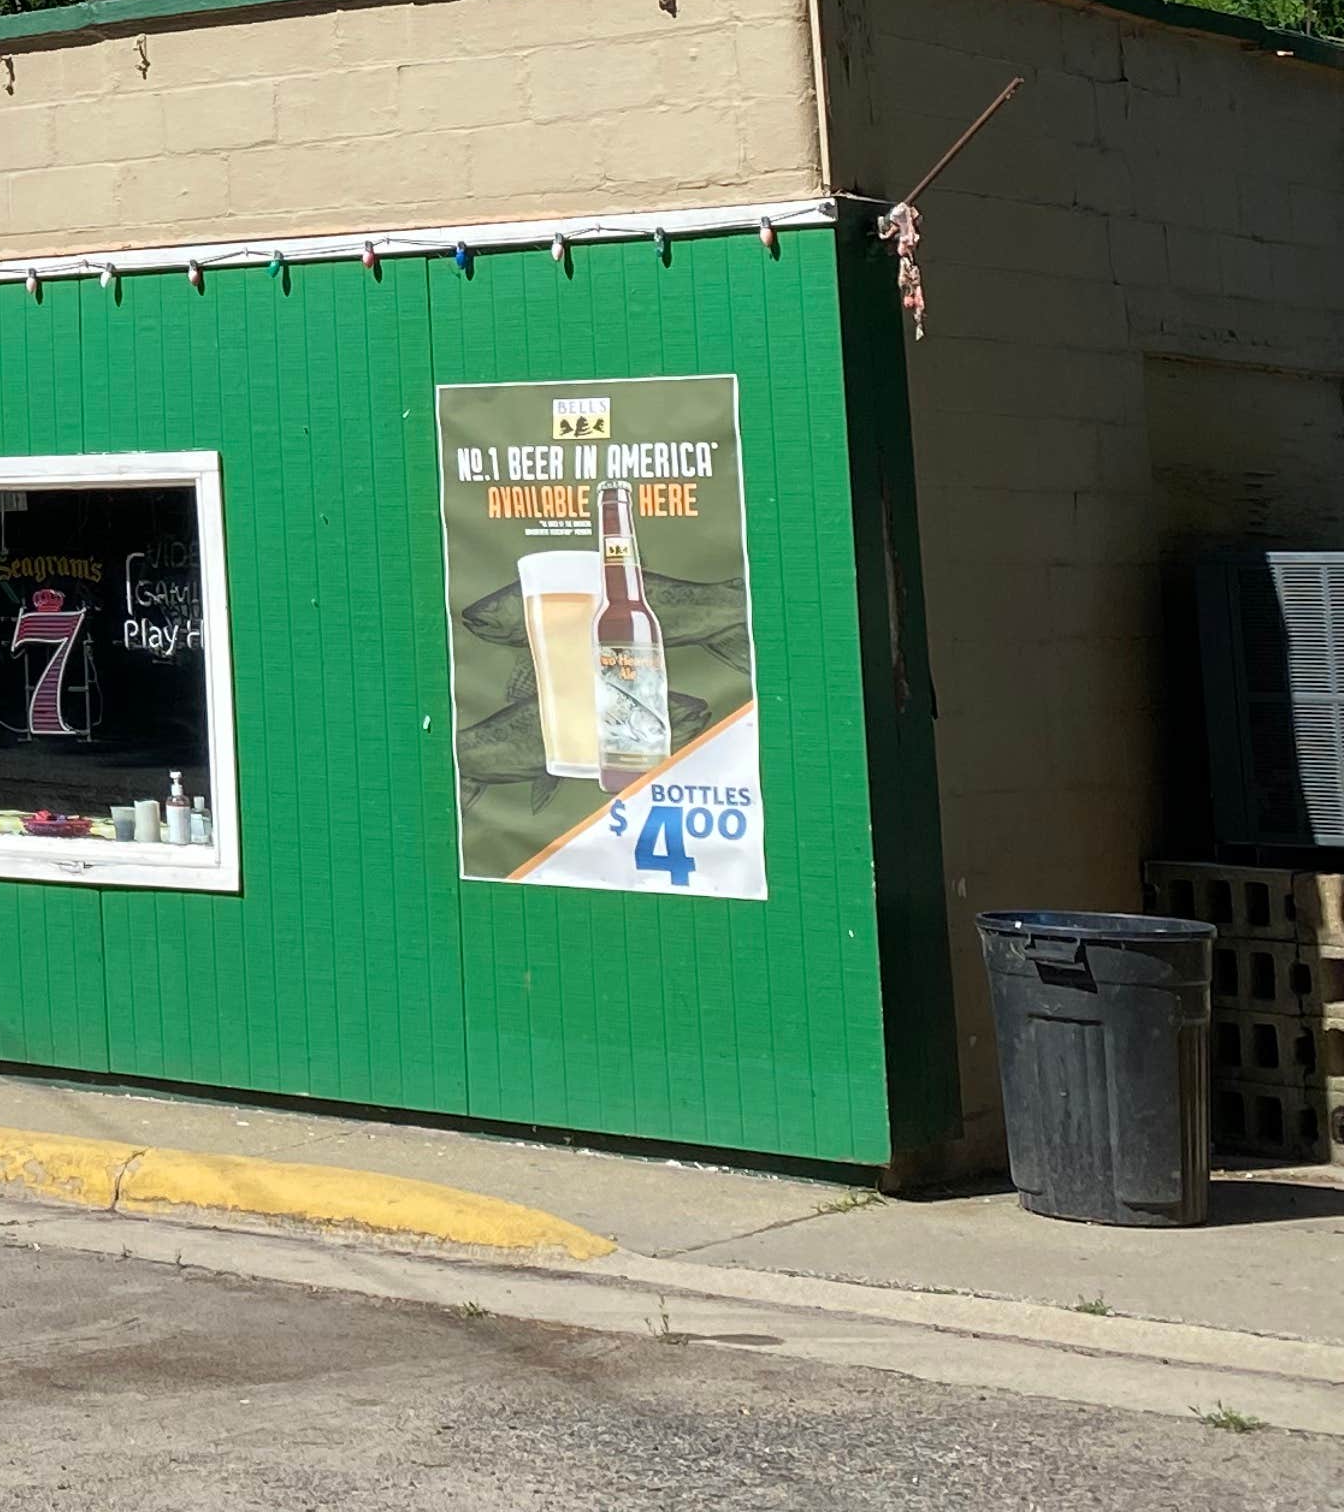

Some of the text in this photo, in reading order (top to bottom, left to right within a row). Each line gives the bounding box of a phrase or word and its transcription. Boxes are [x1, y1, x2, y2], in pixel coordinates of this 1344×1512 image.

[507, 445, 564, 481] BEER
[575, 445, 598, 479] IN
[488, 483, 699, 519] AVAILABLE HERE
[124, 617, 178, 656] Play
[12, 607, 85, 734] 7
[651, 784, 752, 806] BOTTLES
